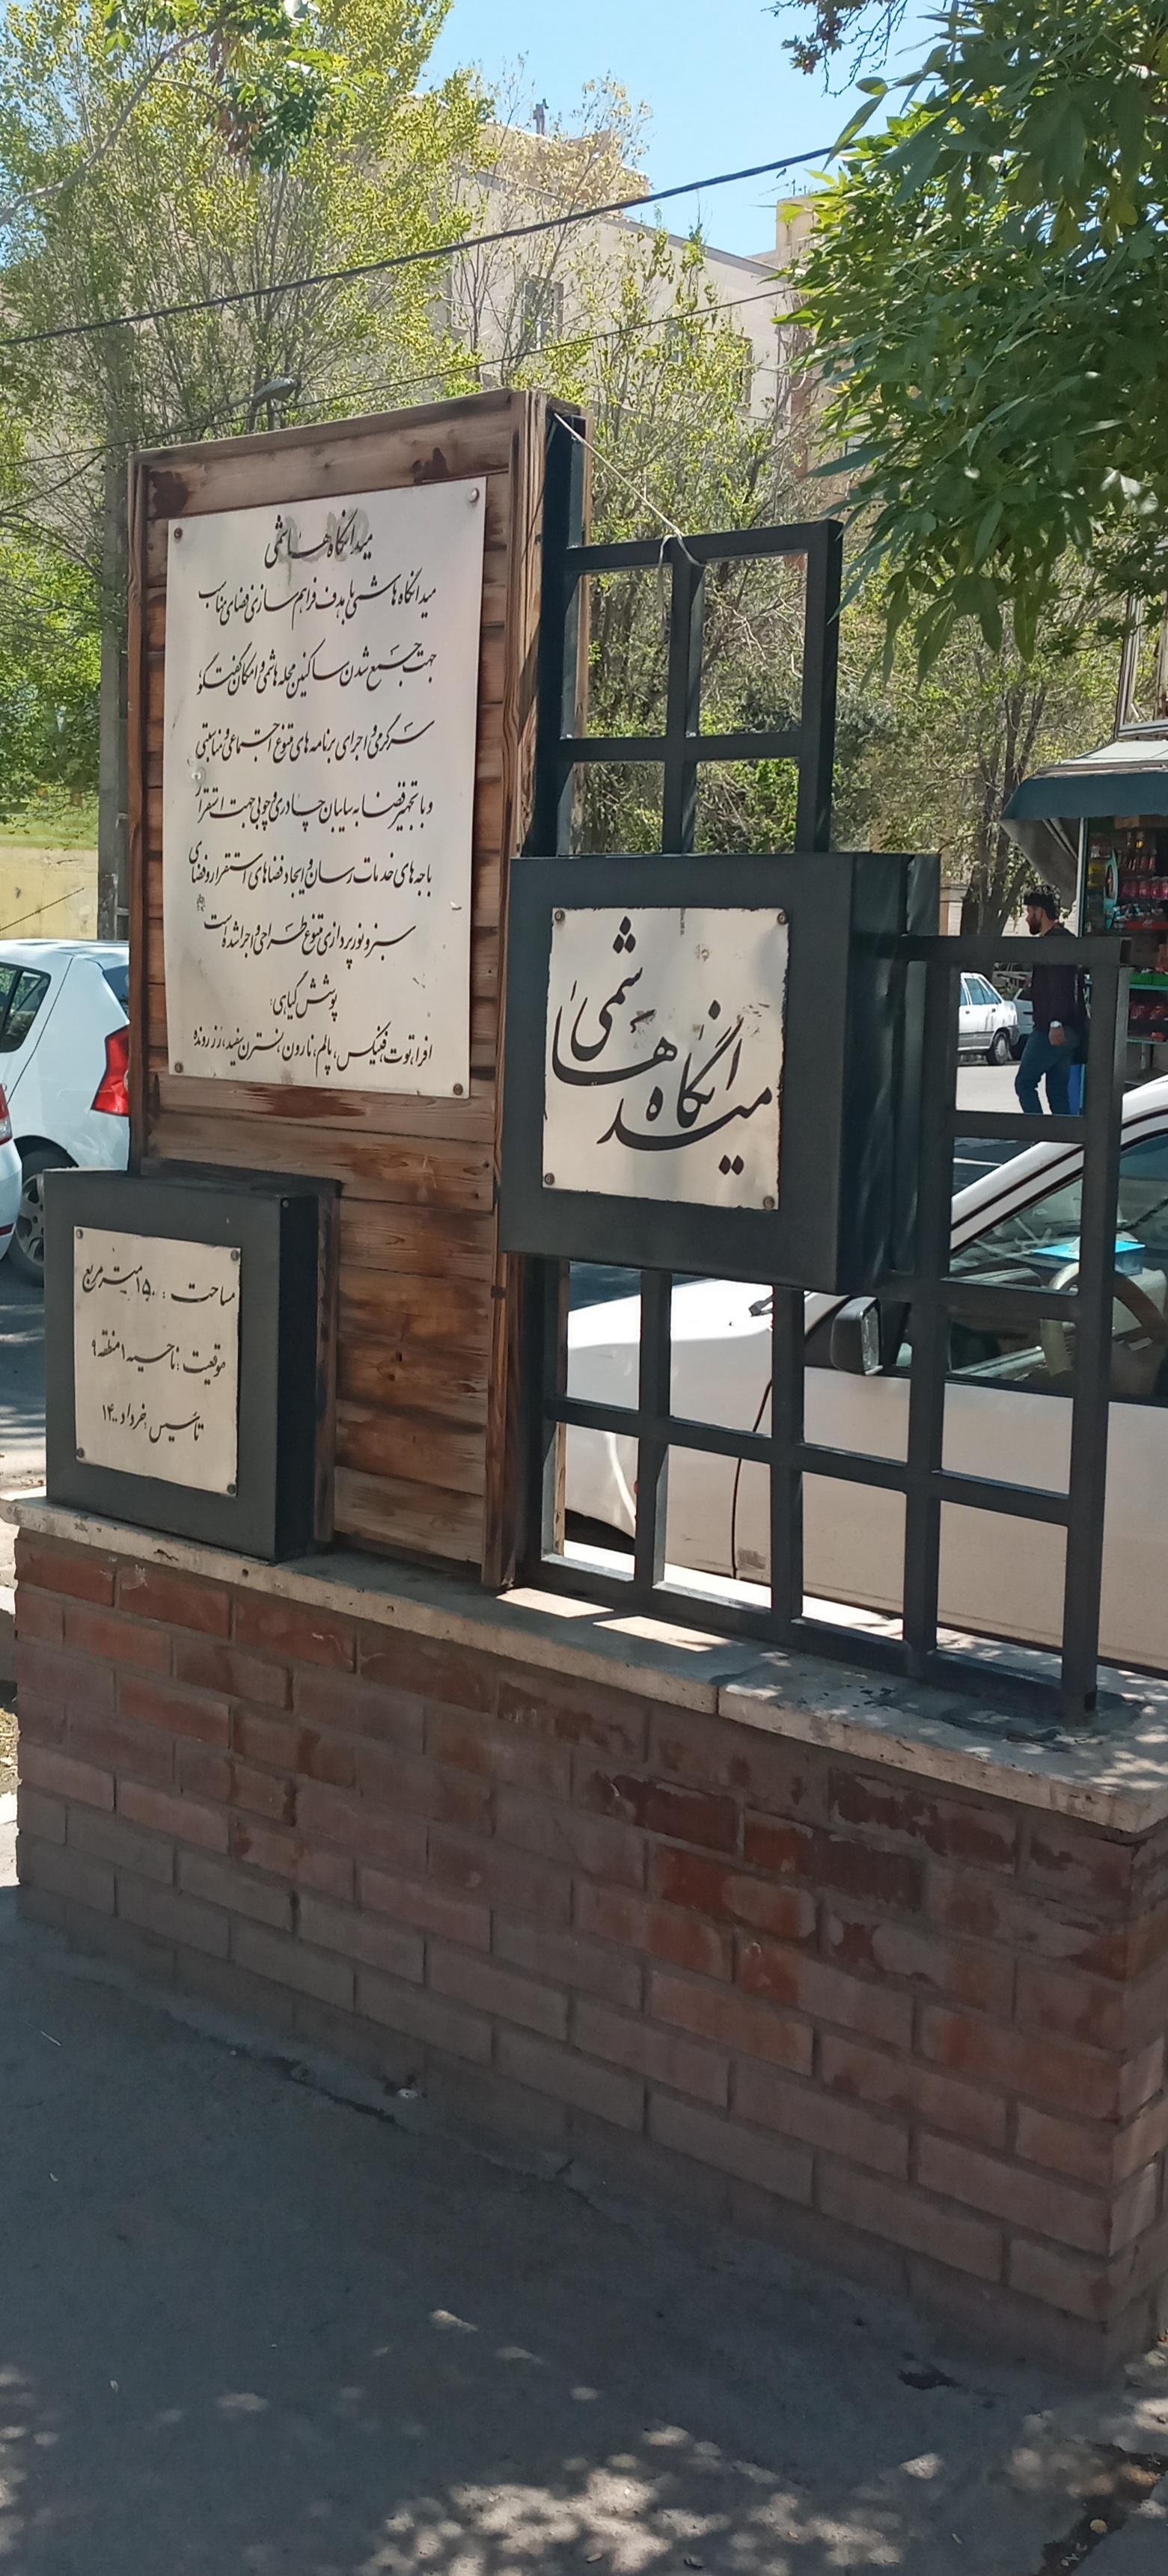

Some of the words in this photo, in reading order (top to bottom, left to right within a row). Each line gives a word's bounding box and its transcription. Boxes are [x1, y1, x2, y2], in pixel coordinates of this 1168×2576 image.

[265, 515, 331, 568] هاشمی
[327, 509, 373, 561] میدانگاه
[198, 581, 227, 613] مناسب
[219, 584, 254, 625] فضای
[292, 577, 317, 630] فراهم
[315, 586, 345, 619] هدف
[345, 574, 401, 619] هاشمی
[398, 568, 435, 619] میدانگاه
[227, 652, 257, 696] امکان
[257, 649, 278, 693] هاشمی
[278, 663, 296, 689] محله
[287, 639, 349, 699] ساکنین
[340, 646, 369, 687] شدن
[403, 649, 436, 684] جهت
[195, 723, 222, 763] مناسبتی
[221, 723, 280, 763] اجتماعی
[273, 723, 294, 764] متنوع
[335, 731, 367, 761] اجرای
[195, 785, 224, 823] استقرار
[210, 797, 255, 829] جهت
[250, 797, 270, 831] چوبی
[269, 794, 325, 832] چادری
[319, 797, 353, 832] سایبان
[362, 782, 406, 818] فضا
[388, 781, 418, 832] تجهیز
[426, 802, 433, 815] و
[189, 841, 208, 883] فضای
[209, 852, 263, 886] استقرار
[284, 867, 305, 898] ایجاد
[221, 921, 239, 948] شده
[239, 925, 254, 959] اجرا
[302, 913, 323, 955] متنوع
[365, 923, 416, 961] سبز
[296, 974, 337, 1022] پوشش
[552, 916, 678, 1086] هاشمی
[238, 1028, 284, 1061] نسترن
[597, 1000, 772, 1175] میدانگاه
[82, 1264, 103, 1292] مربع
[98, 1266, 142, 1289] متر
[97, 1330, 120, 1357] منطقه
[126, 1343, 180, 1373] ناحیه
[120, 1403, 147, 1429] خرداد
